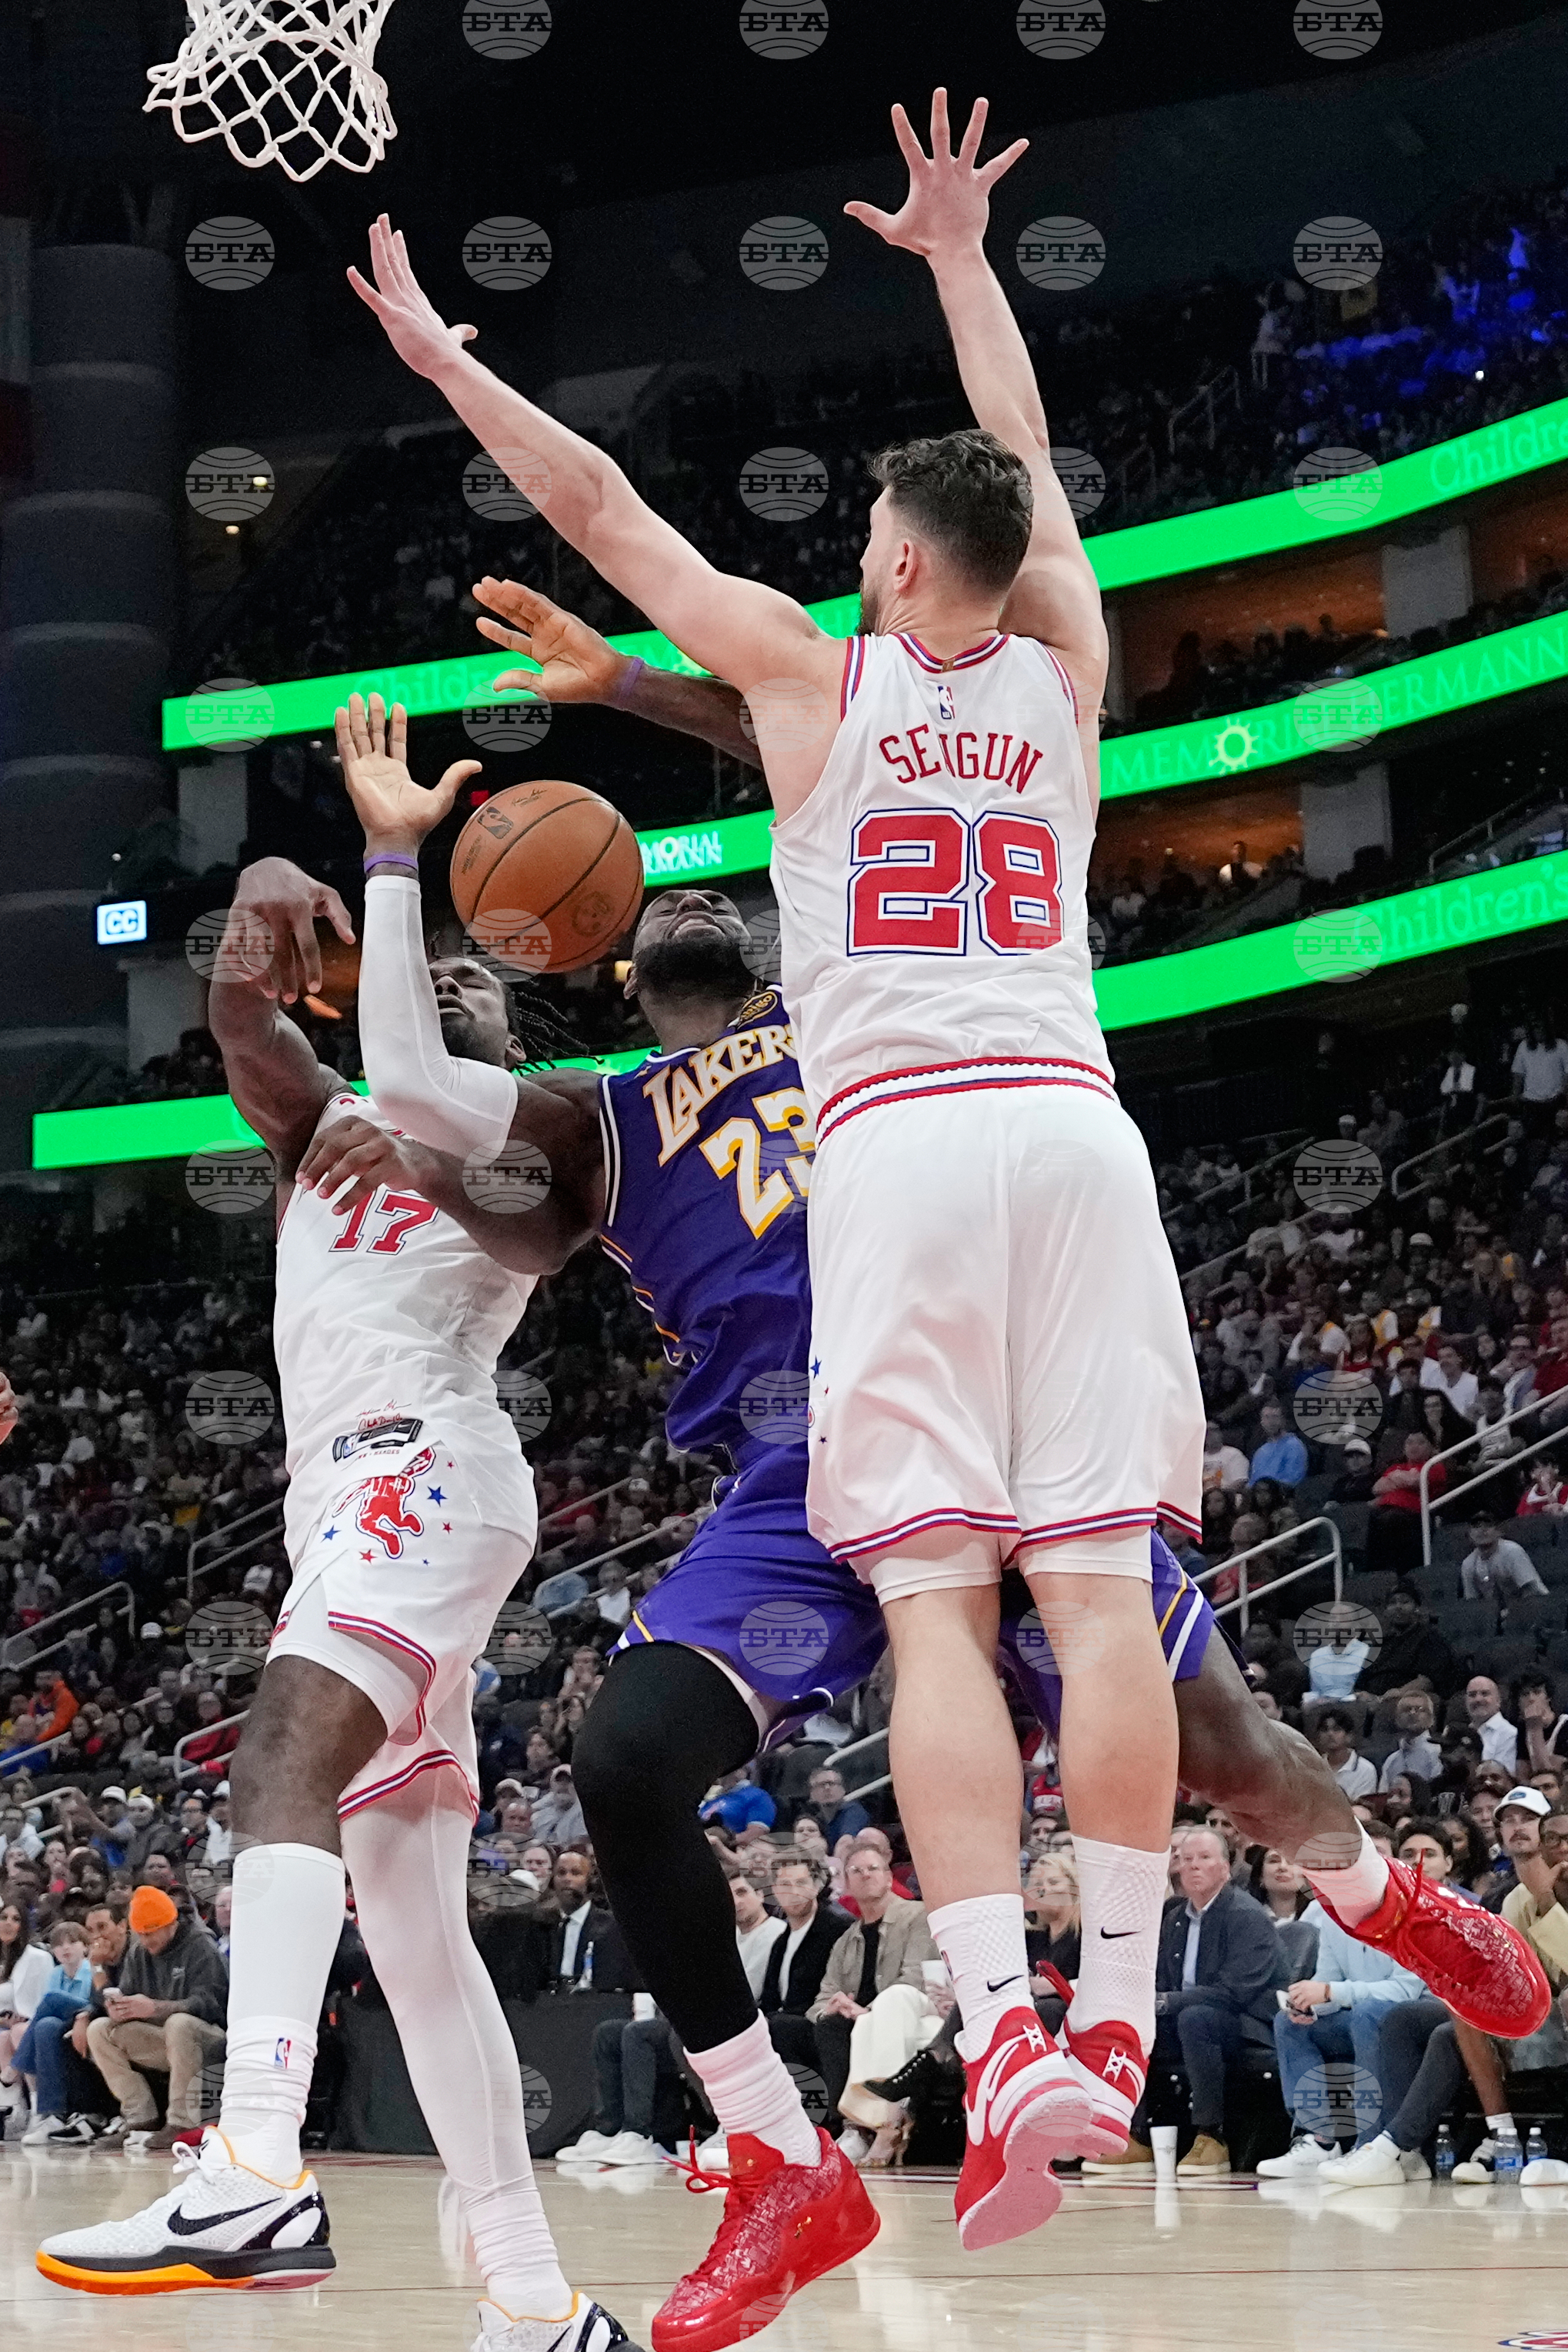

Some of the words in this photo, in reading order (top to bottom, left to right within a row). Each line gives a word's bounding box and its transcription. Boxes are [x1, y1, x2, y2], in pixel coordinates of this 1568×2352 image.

[105, 909, 138, 936] CC
[847, 807, 1065, 956] 28
[698, 1086, 816, 1240] 23
[329, 1189, 439, 1256] 17
